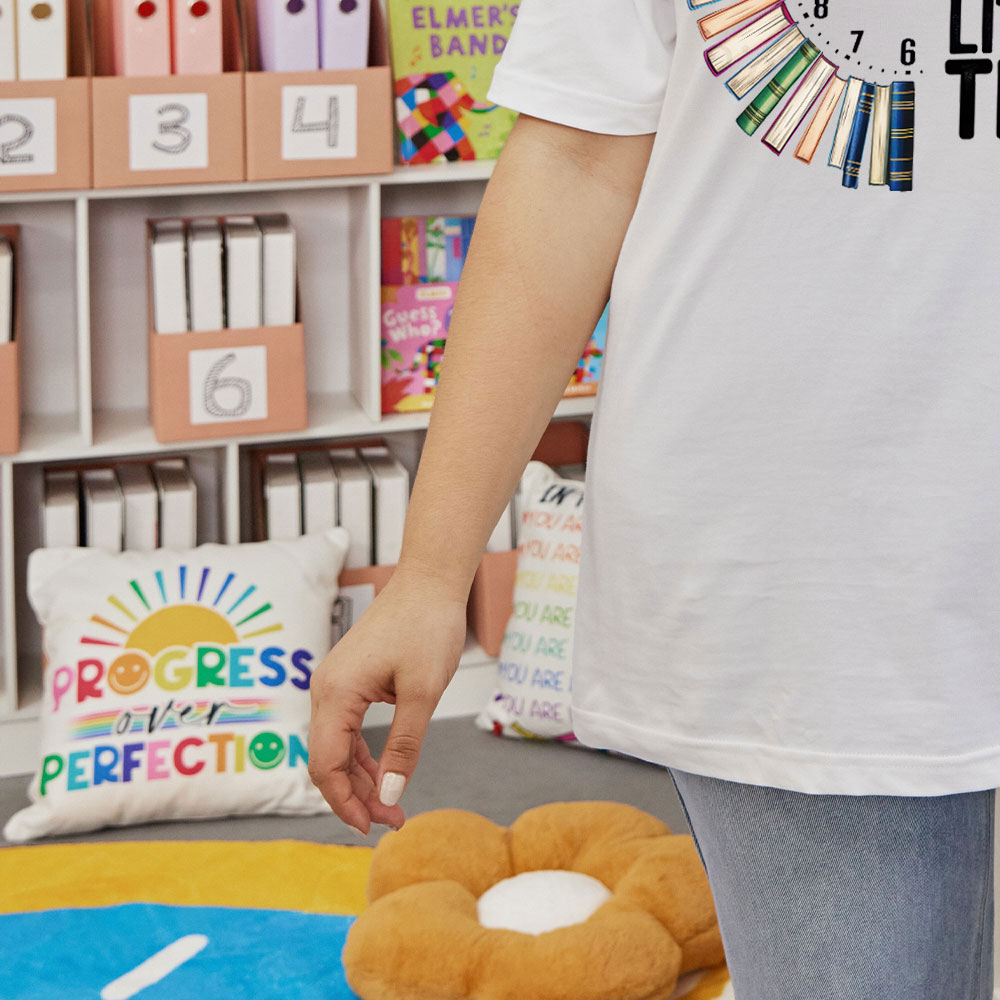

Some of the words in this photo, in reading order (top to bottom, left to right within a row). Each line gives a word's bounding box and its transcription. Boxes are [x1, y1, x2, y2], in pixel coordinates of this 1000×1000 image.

[429, 34, 508, 59] BAND
[850, 30, 864, 55] 7
[900, 38, 917, 67] 6
[152, 103, 192, 155] 3
[291, 95, 340, 148] 4
[0, 114, 35, 164] 2
[382, 305, 438, 327] Guess
[388, 318, 443, 343] Who?
[204, 352, 252, 418] 6
[514, 601, 539, 622] OU
[539, 604, 574, 629] ARE
[535, 636, 568, 660] ARE
[52, 646, 314, 713] PROGRESS
[531, 667, 565, 692] ARE
[115, 698, 232, 735] over
[40, 731, 310, 796] PERFECTION
